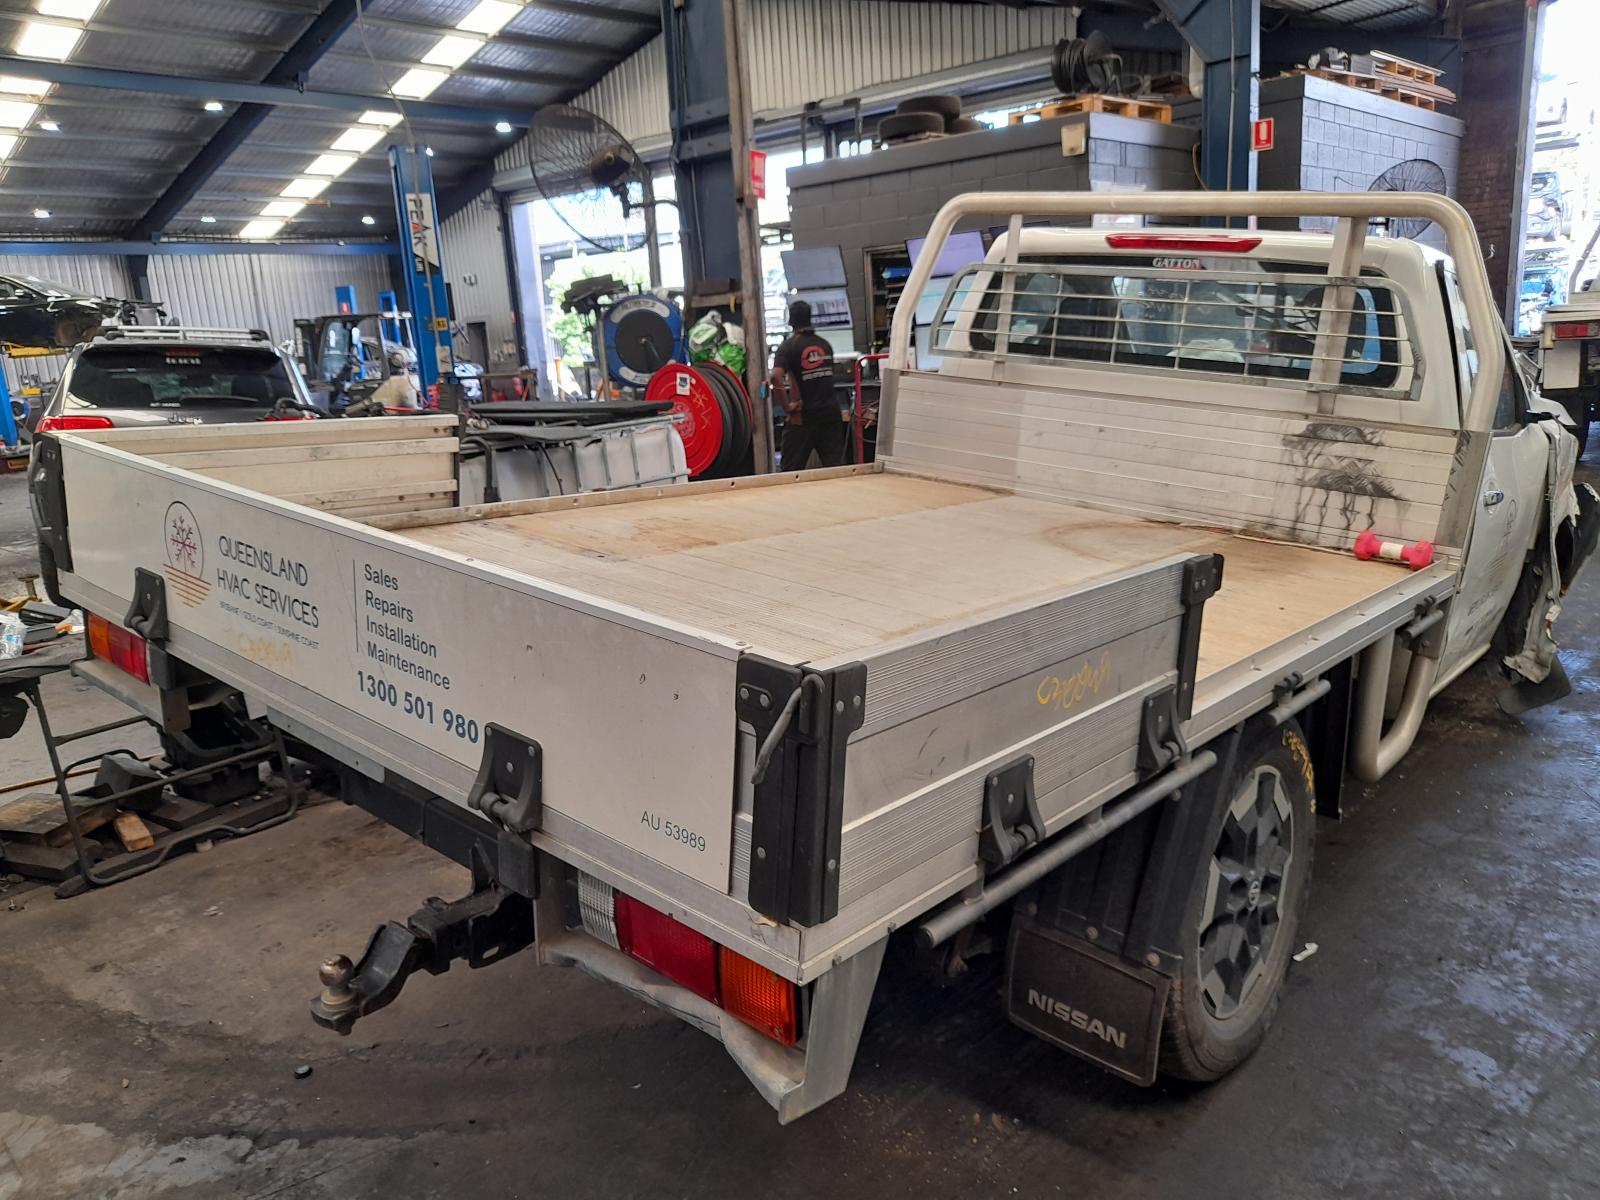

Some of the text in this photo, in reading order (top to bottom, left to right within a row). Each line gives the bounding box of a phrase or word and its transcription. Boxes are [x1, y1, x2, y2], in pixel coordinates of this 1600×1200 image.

[408, 198, 432, 247] PEAK
[1152, 257, 1200, 270] GATTON
[218, 535, 308, 587] QUEENSLAND
[364, 563, 399, 591] Sales
[216, 567, 251, 600] HVAC
[254, 583, 319, 629] SERVICES
[365, 589, 414, 623] Repairs
[366, 615, 437, 659] Installation
[367, 640, 451, 690] Maintenance
[357, 670, 479, 744] 1300 501 980
[640, 810, 706, 852] AU 53989
[1027, 988, 1127, 1049] NISSAN
